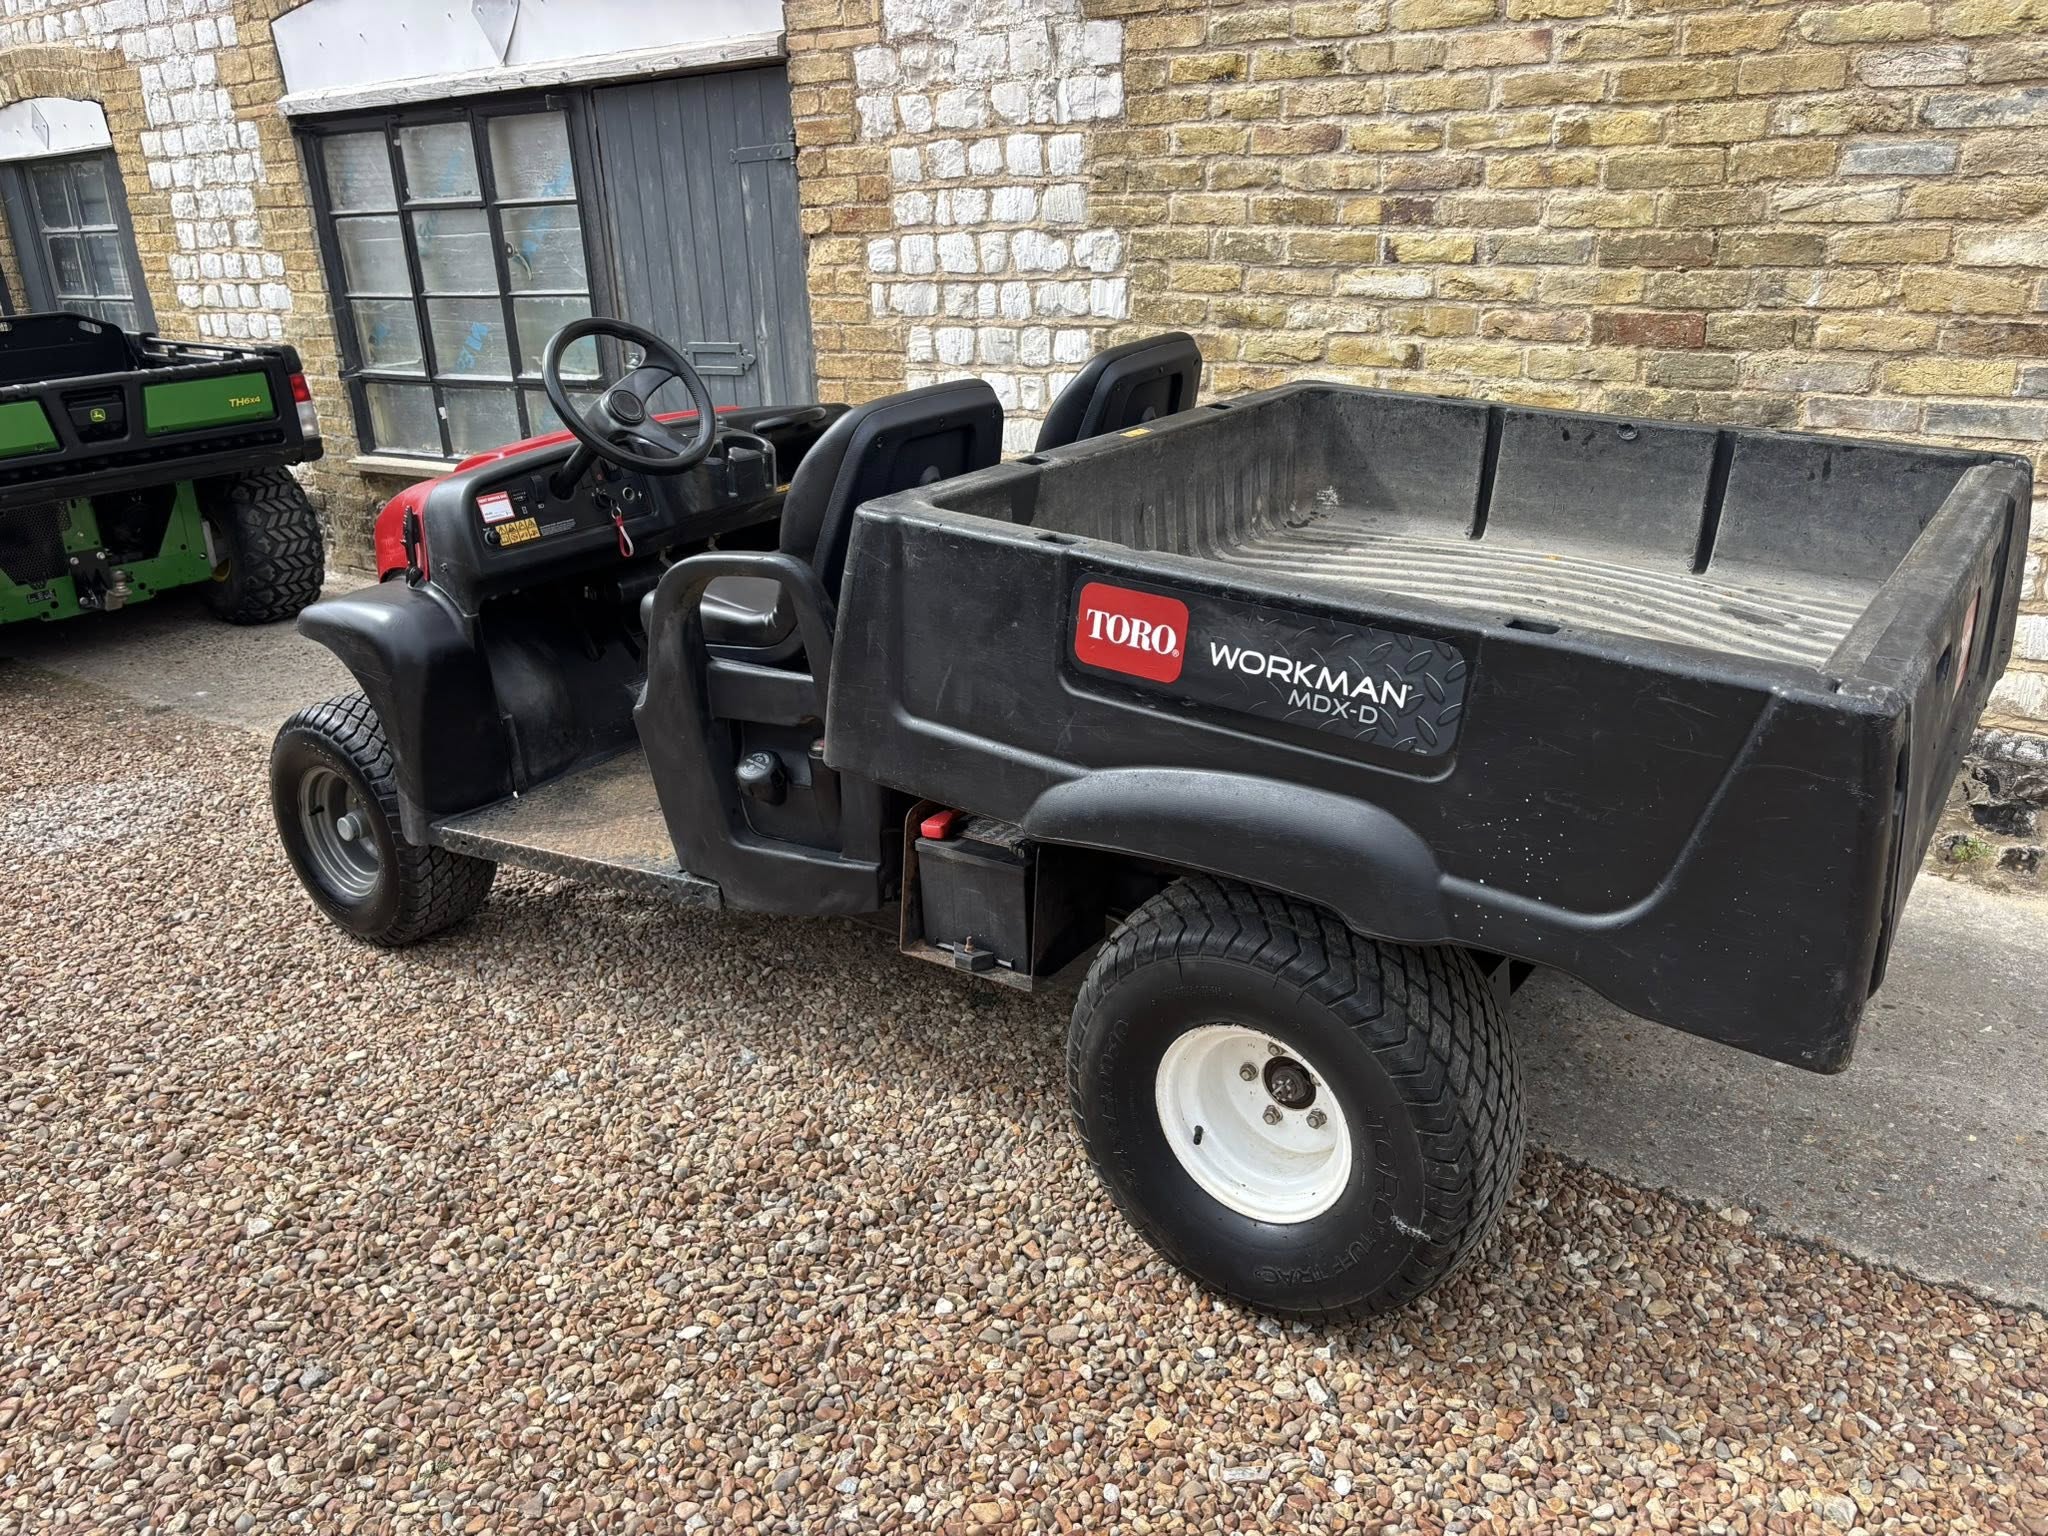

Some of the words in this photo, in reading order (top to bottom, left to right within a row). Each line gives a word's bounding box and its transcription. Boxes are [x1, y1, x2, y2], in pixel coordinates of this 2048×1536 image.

[1086, 608, 1177, 655] TORO
[1210, 641, 1409, 709] WORKMAN
[1287, 688, 1378, 725] MDX-D
